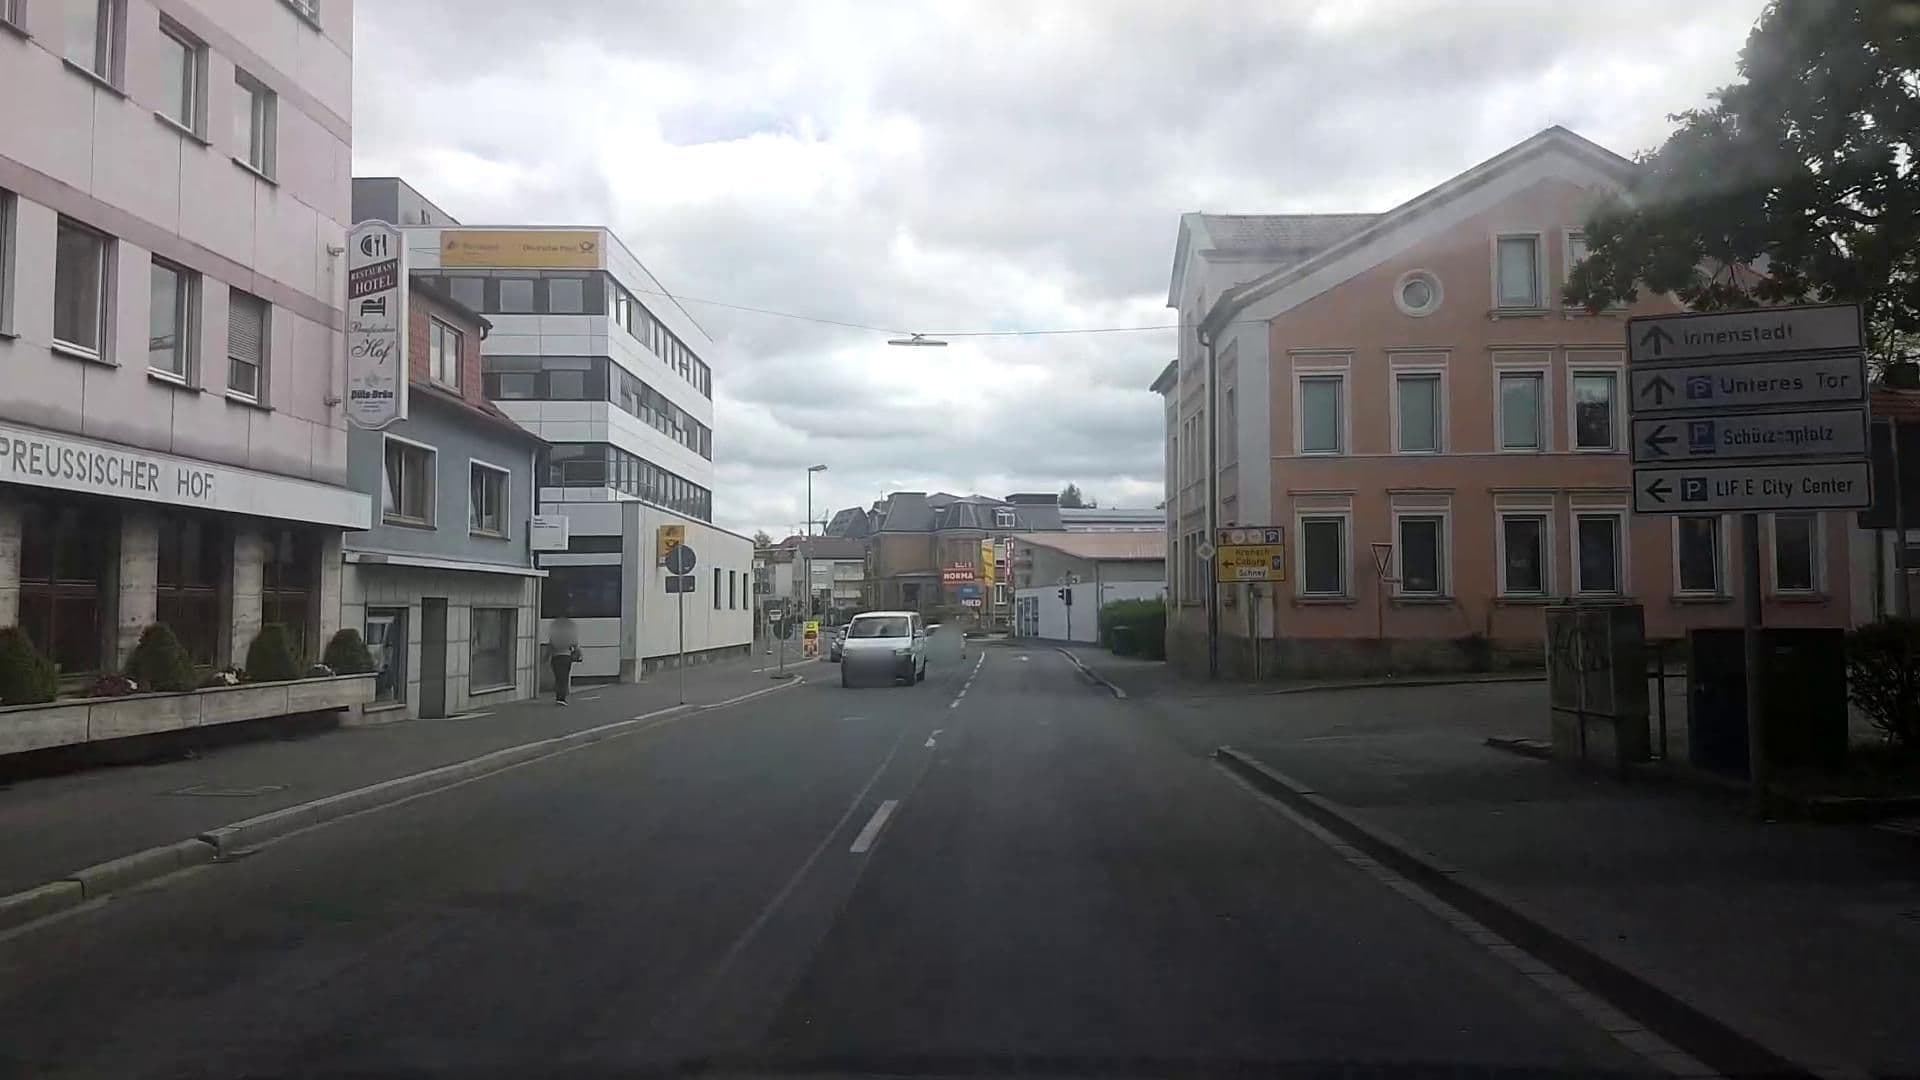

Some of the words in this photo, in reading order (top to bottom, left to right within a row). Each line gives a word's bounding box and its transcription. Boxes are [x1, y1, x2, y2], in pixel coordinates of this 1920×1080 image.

[351, 262, 397, 280] RESTAURANT
[355, 275, 393, 295] HOTEL
[1684, 324, 1794, 345] Innenstadt
[351, 339, 395, 365] Hof
[1720, 375, 1804, 395] Unteres
[1815, 372, 1849, 389] Tor
[0, 436, 160, 493] PREUSSISCHER
[177, 468, 214, 500] HOF
[1762, 479, 1793, 498] City
[1802, 477, 1854, 495] Center
[943, 572, 974, 580] NORMA
